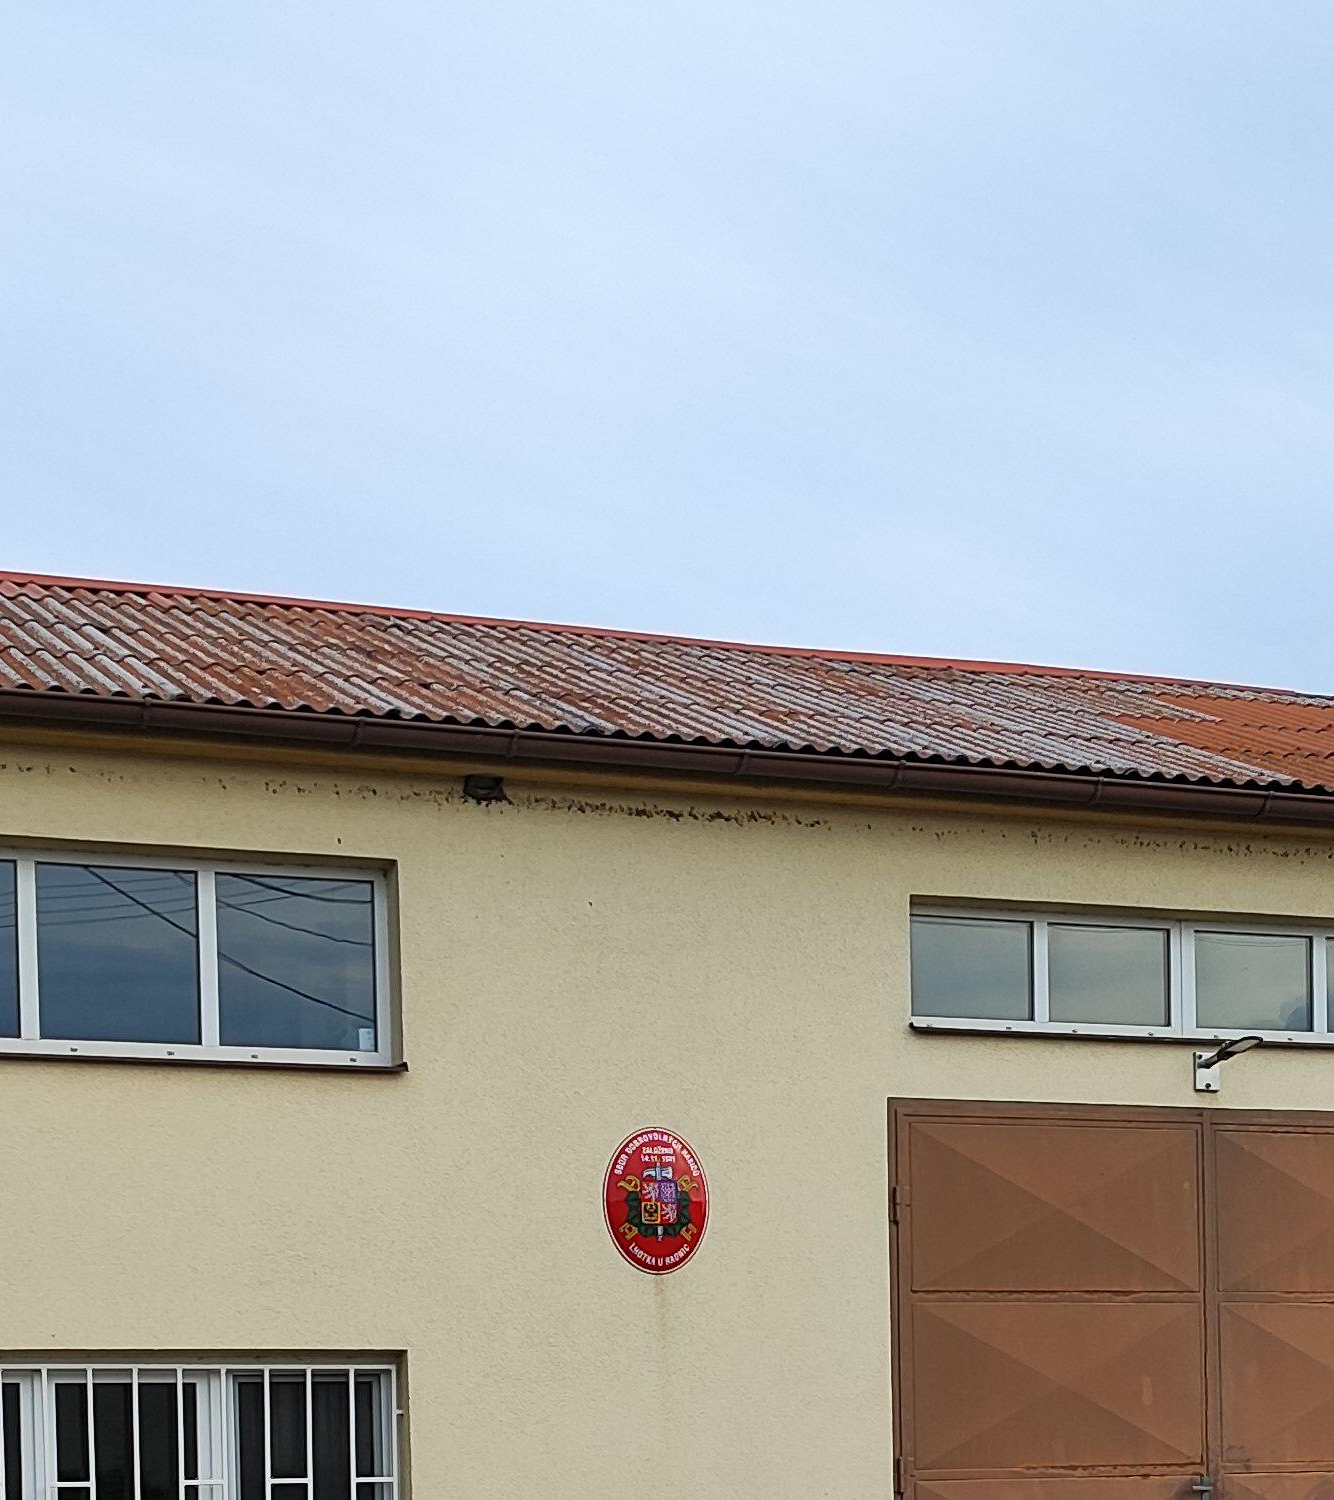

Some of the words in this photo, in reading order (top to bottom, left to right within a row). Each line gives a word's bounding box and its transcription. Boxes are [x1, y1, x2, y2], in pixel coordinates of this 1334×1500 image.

[629, 1242, 656, 1265] LHOTKA
[657, 1257, 664, 1266] U
[665, 1243, 690, 1265] RADNIC
